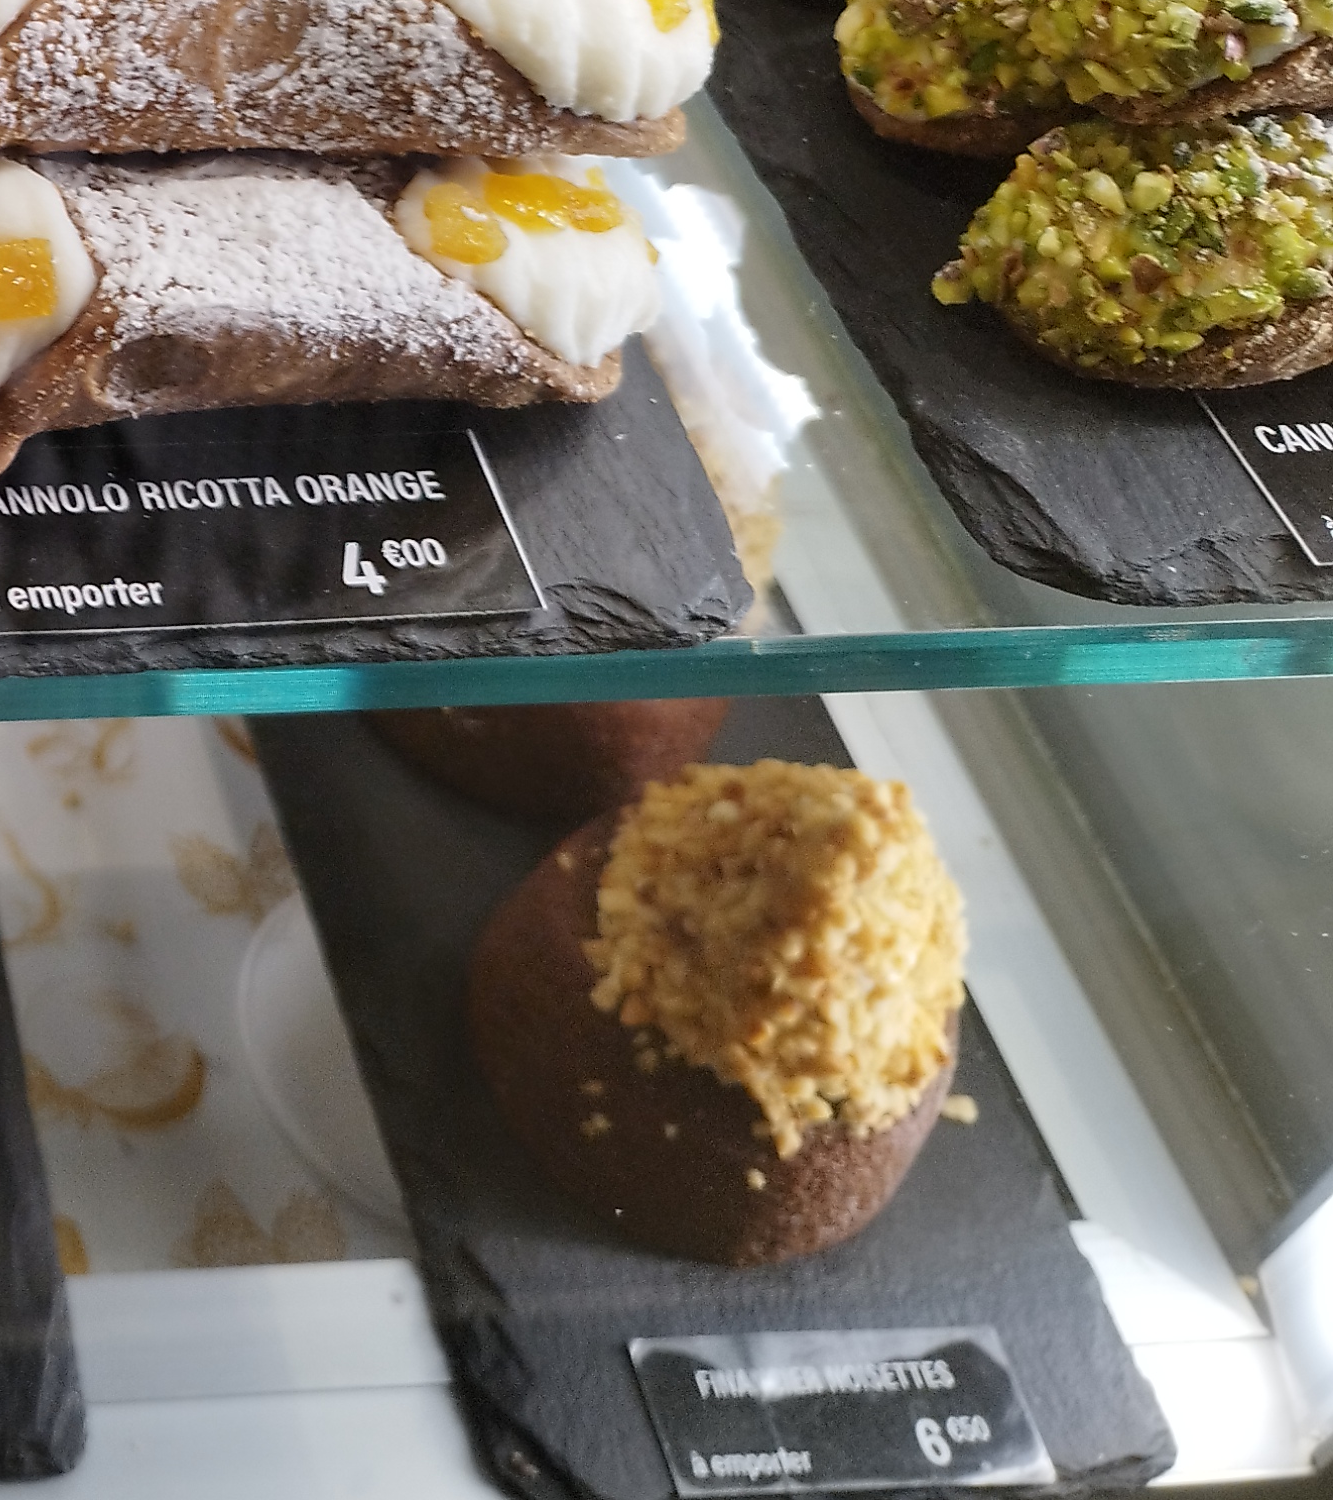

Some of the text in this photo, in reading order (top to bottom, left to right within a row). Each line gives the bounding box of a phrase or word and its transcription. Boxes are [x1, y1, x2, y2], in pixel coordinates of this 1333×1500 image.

[140, 478, 291, 513] RICOTTA
[297, 470, 445, 506] ORANGE
[8, 577, 163, 616] emporter
[824, 1360, 956, 1393] NOISETTES
